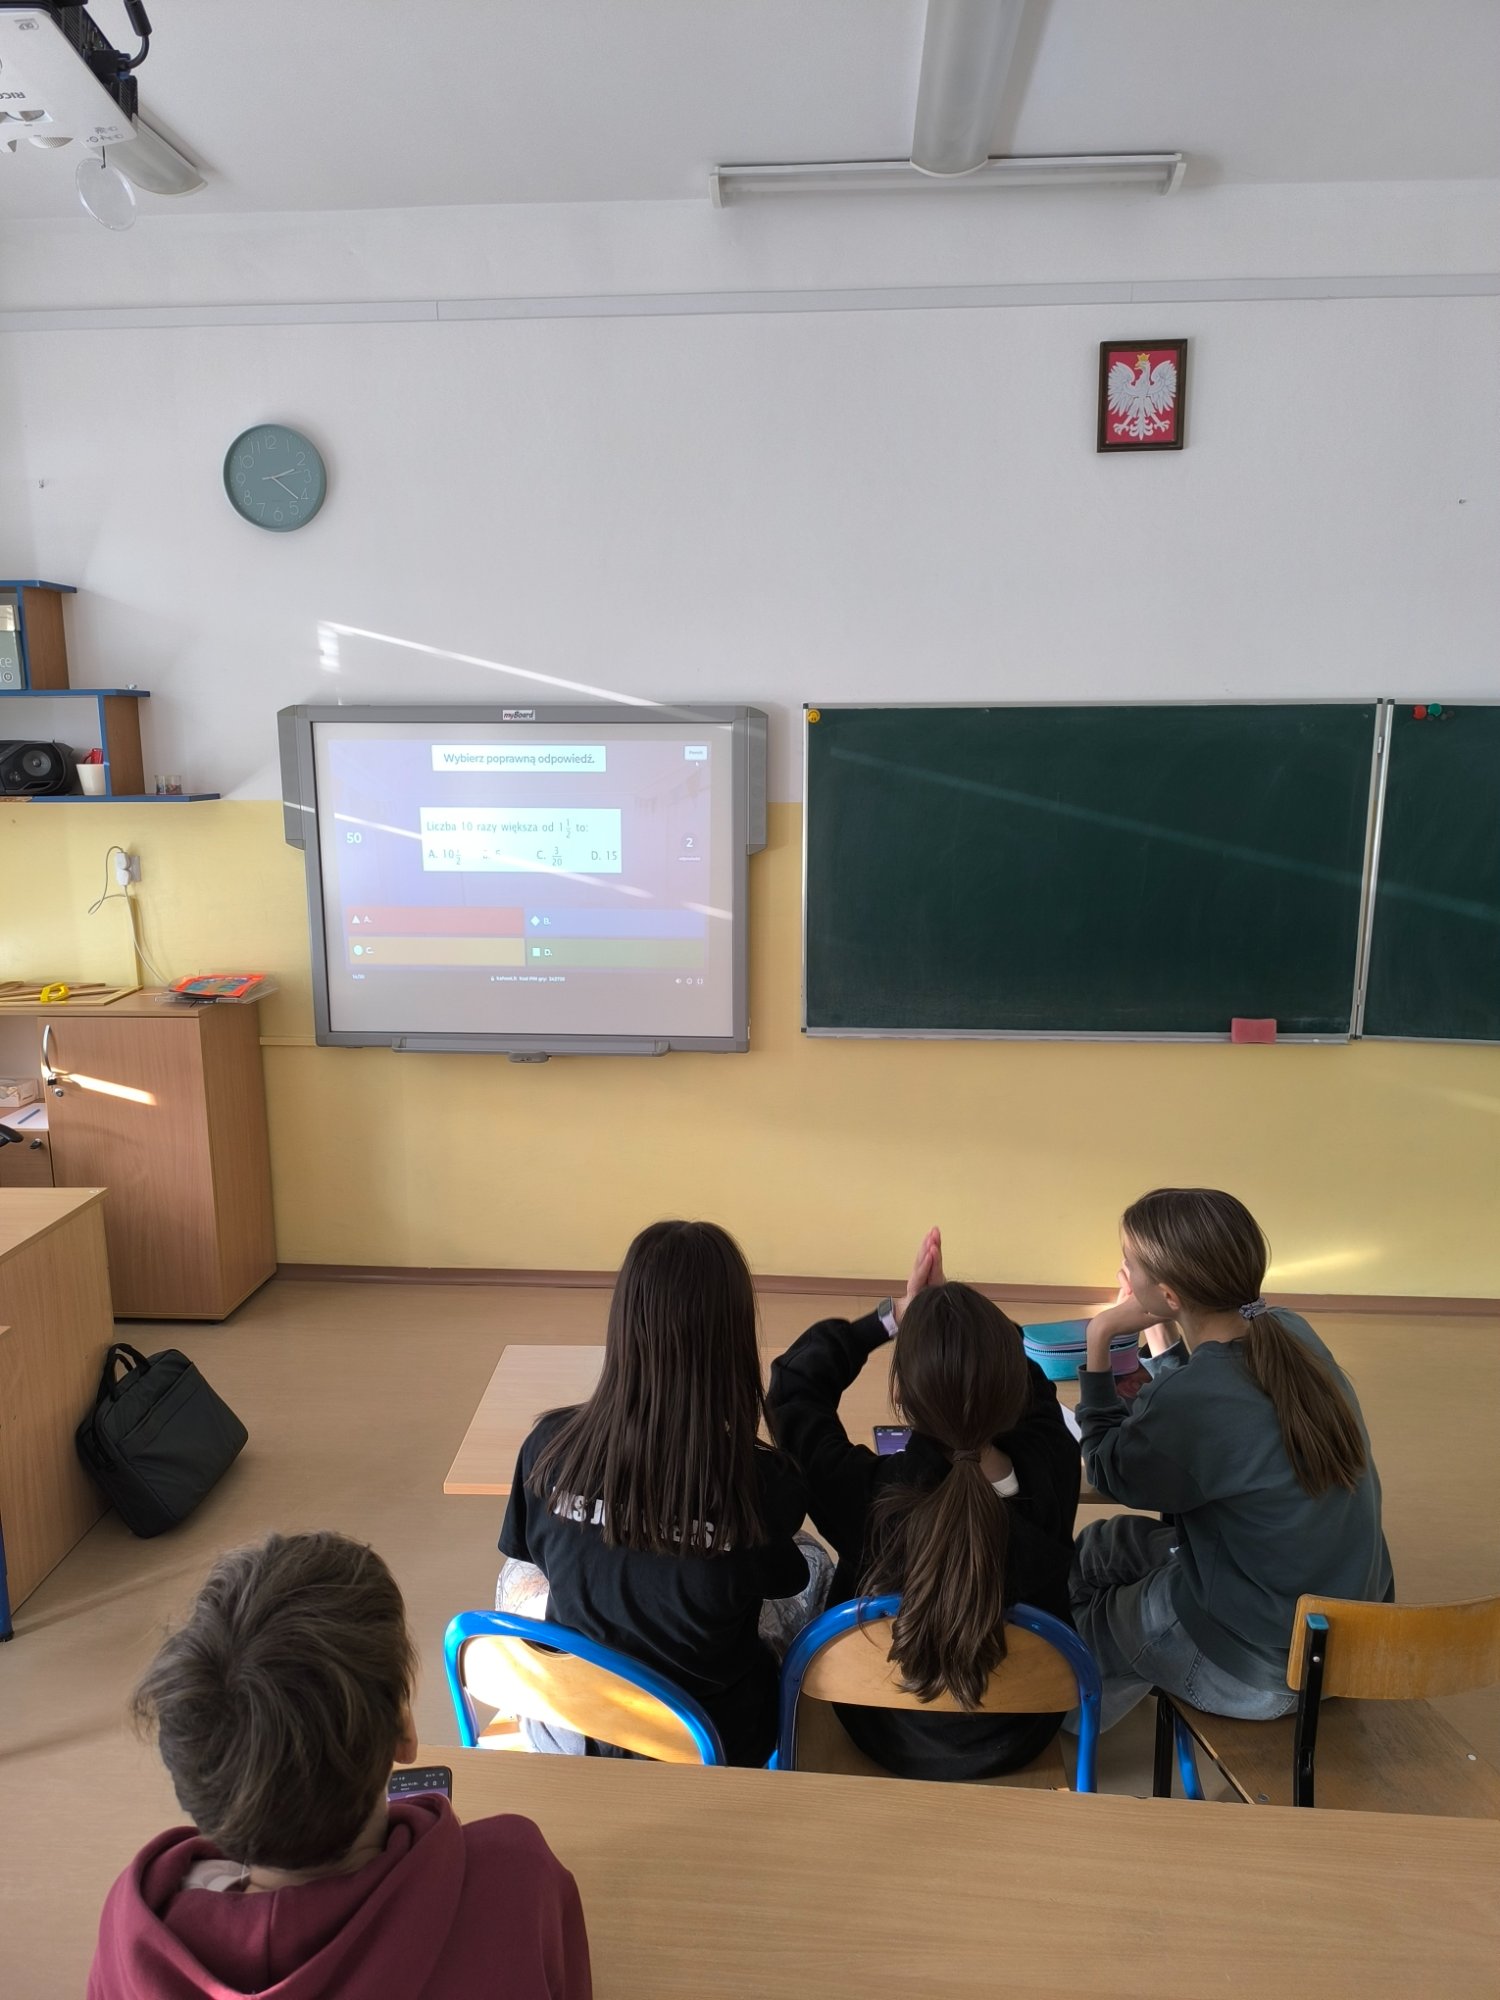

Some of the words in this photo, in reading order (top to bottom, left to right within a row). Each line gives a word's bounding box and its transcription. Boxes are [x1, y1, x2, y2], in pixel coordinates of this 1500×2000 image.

[250, 439, 261, 455] 11
[264, 434, 277, 450] 12
[239, 454, 255, 470] 10
[295, 451, 306, 466] 2
[235, 472, 246, 487] 9
[303, 469, 312, 484] 3
[243, 489, 253, 506] 8
[300, 487, 309, 500] 4
[256, 502, 266, 518] 7
[273, 507, 284, 522] 6
[289, 500, 300, 515] 5
[443, 753, 485, 765] Wybierz
[486, 755, 536, 766] poprawną
[537, 753, 595, 765] odpowiedź.
[426, 821, 457, 832] Liczba
[461, 821, 473, 832] 10
[476, 823, 497, 834] razy
[501, 821, 538, 834] większa
[541, 821, 554, 832] od
[575, 823, 589, 833] to:
[346, 831, 362, 844] 50
[685, 837, 694, 848] 2
[428, 849, 438, 859] A.
[443, 849, 454, 859] 10
[536, 850, 546, 860] C.
[591, 850, 602, 861] D.
[606, 850, 618, 861] 15
[544, 948, 553, 956] D.
